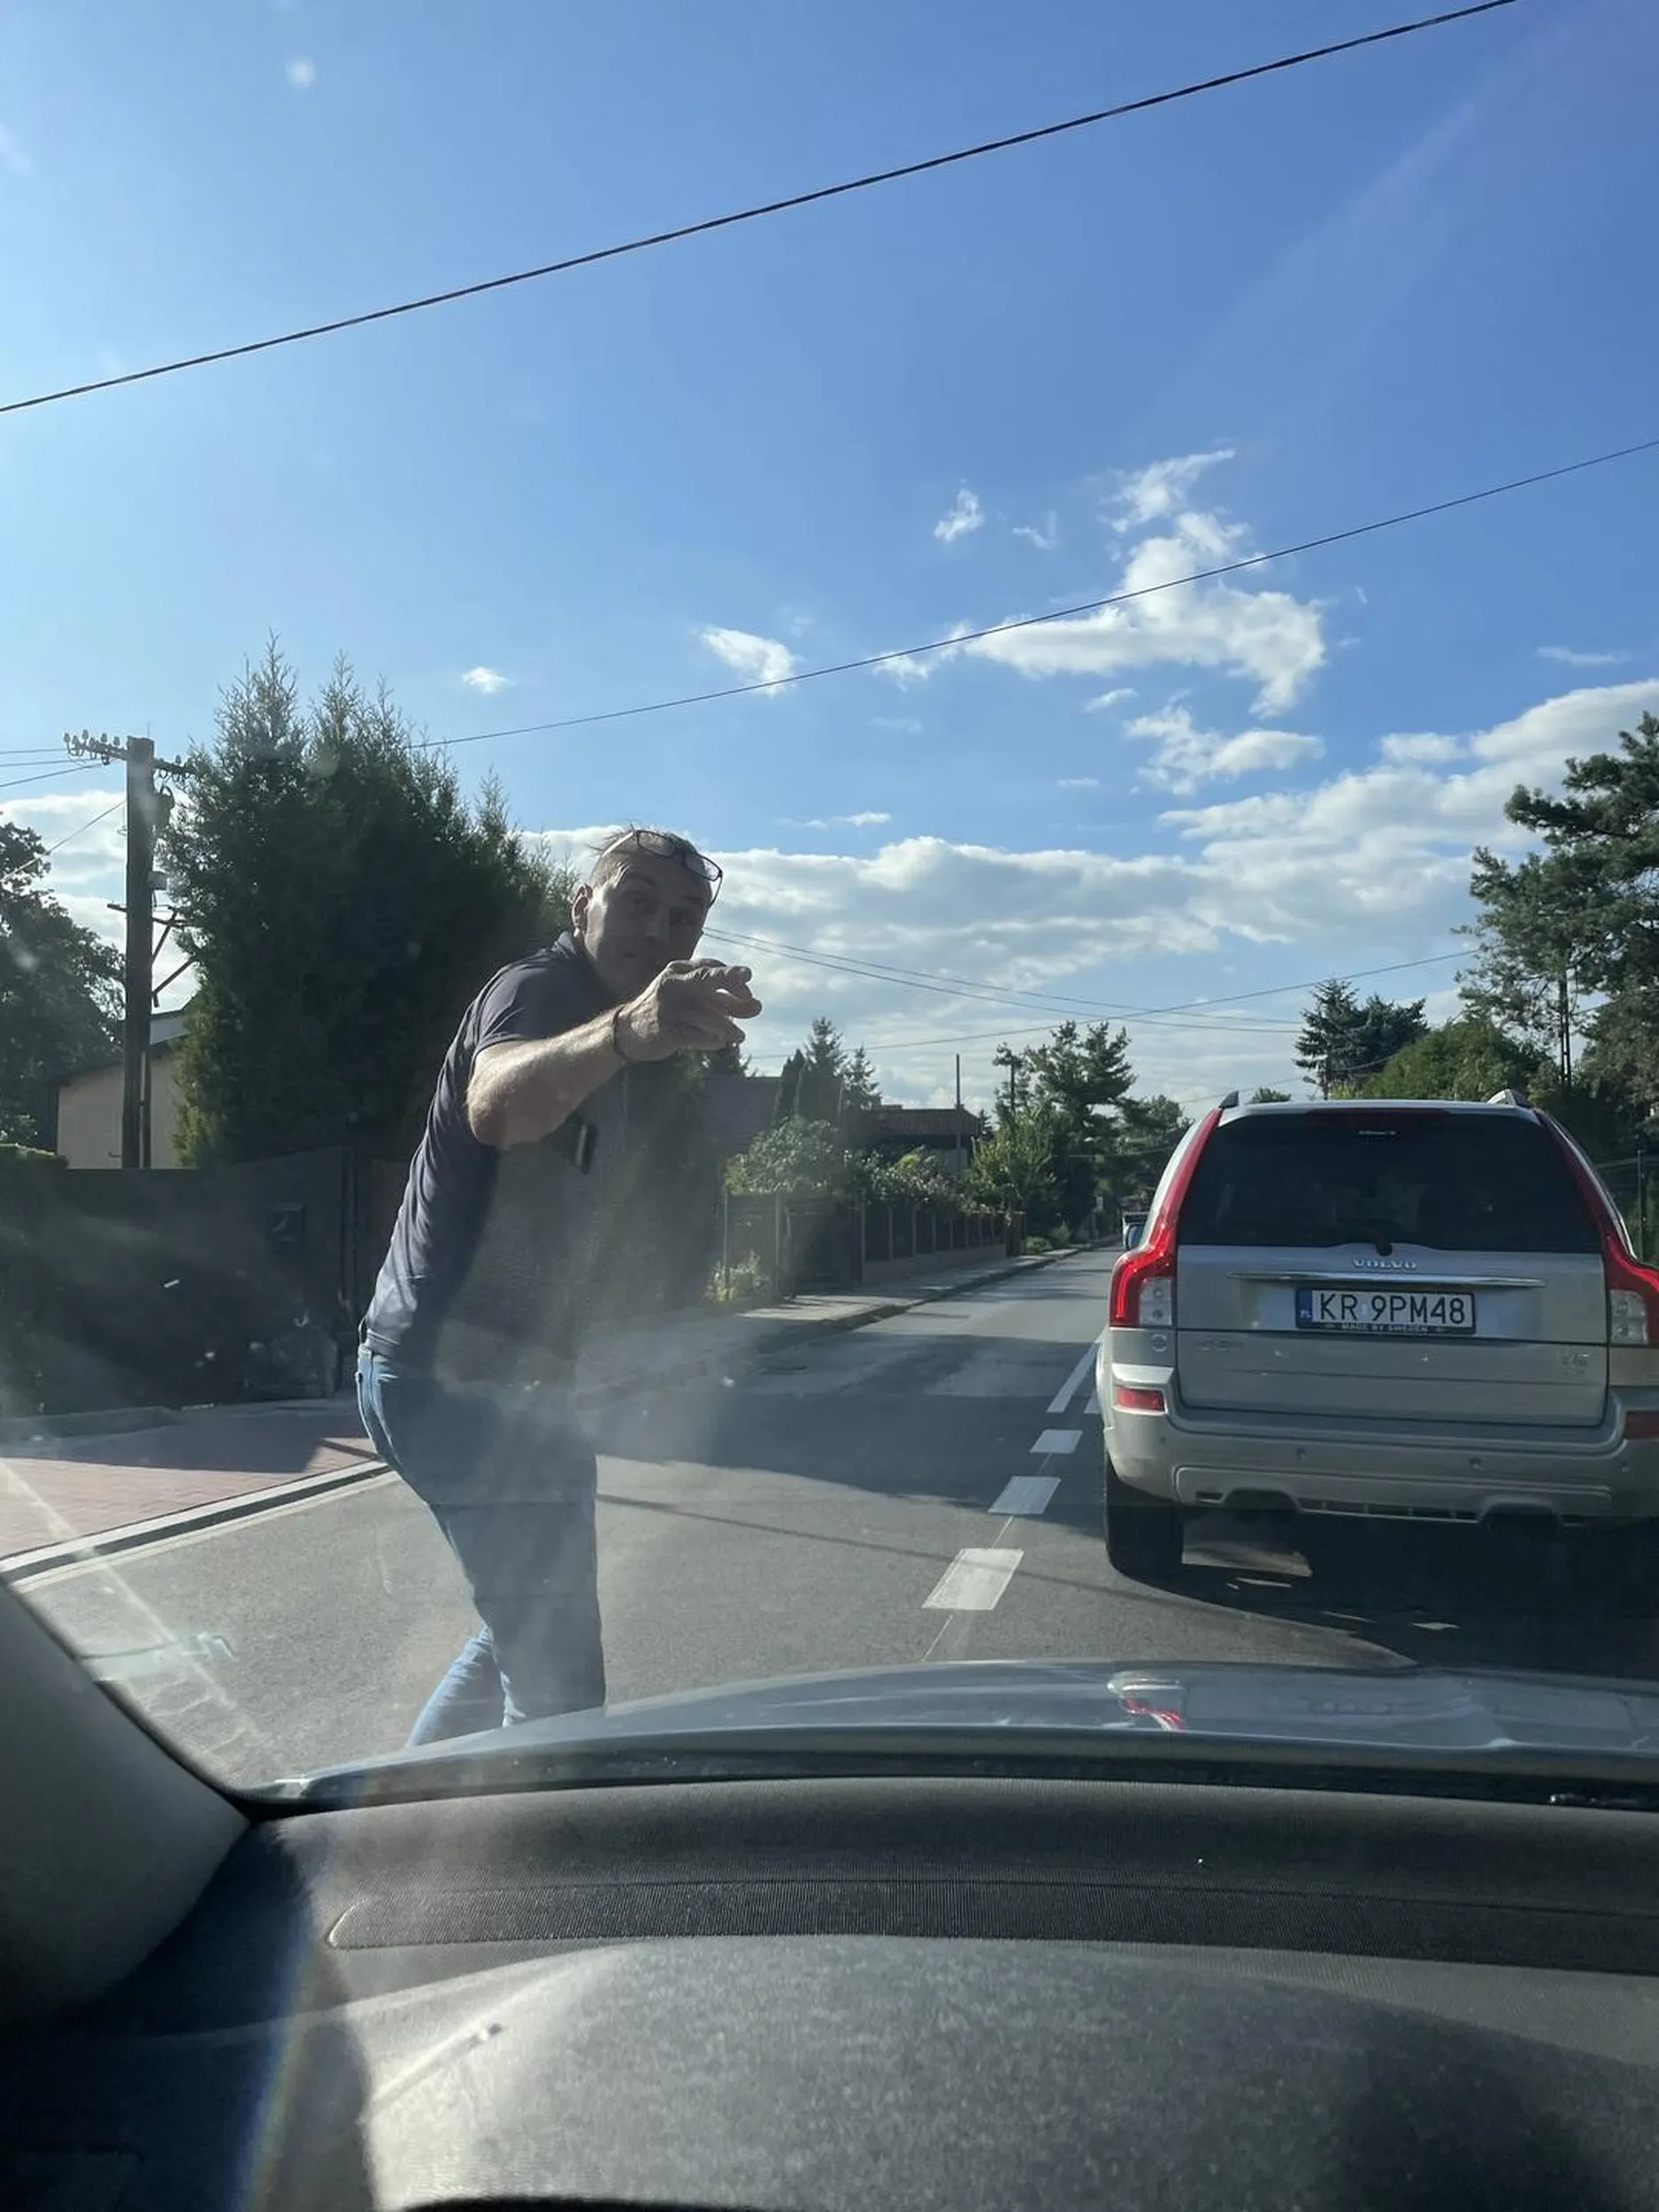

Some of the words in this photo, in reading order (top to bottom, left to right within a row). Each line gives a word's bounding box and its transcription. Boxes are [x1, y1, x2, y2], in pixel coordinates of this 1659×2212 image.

[1352, 1259, 1417, 1271] VOLVO
[1320, 1293, 1358, 1321] KR
[1371, 1294, 1465, 1325] 9PM48
